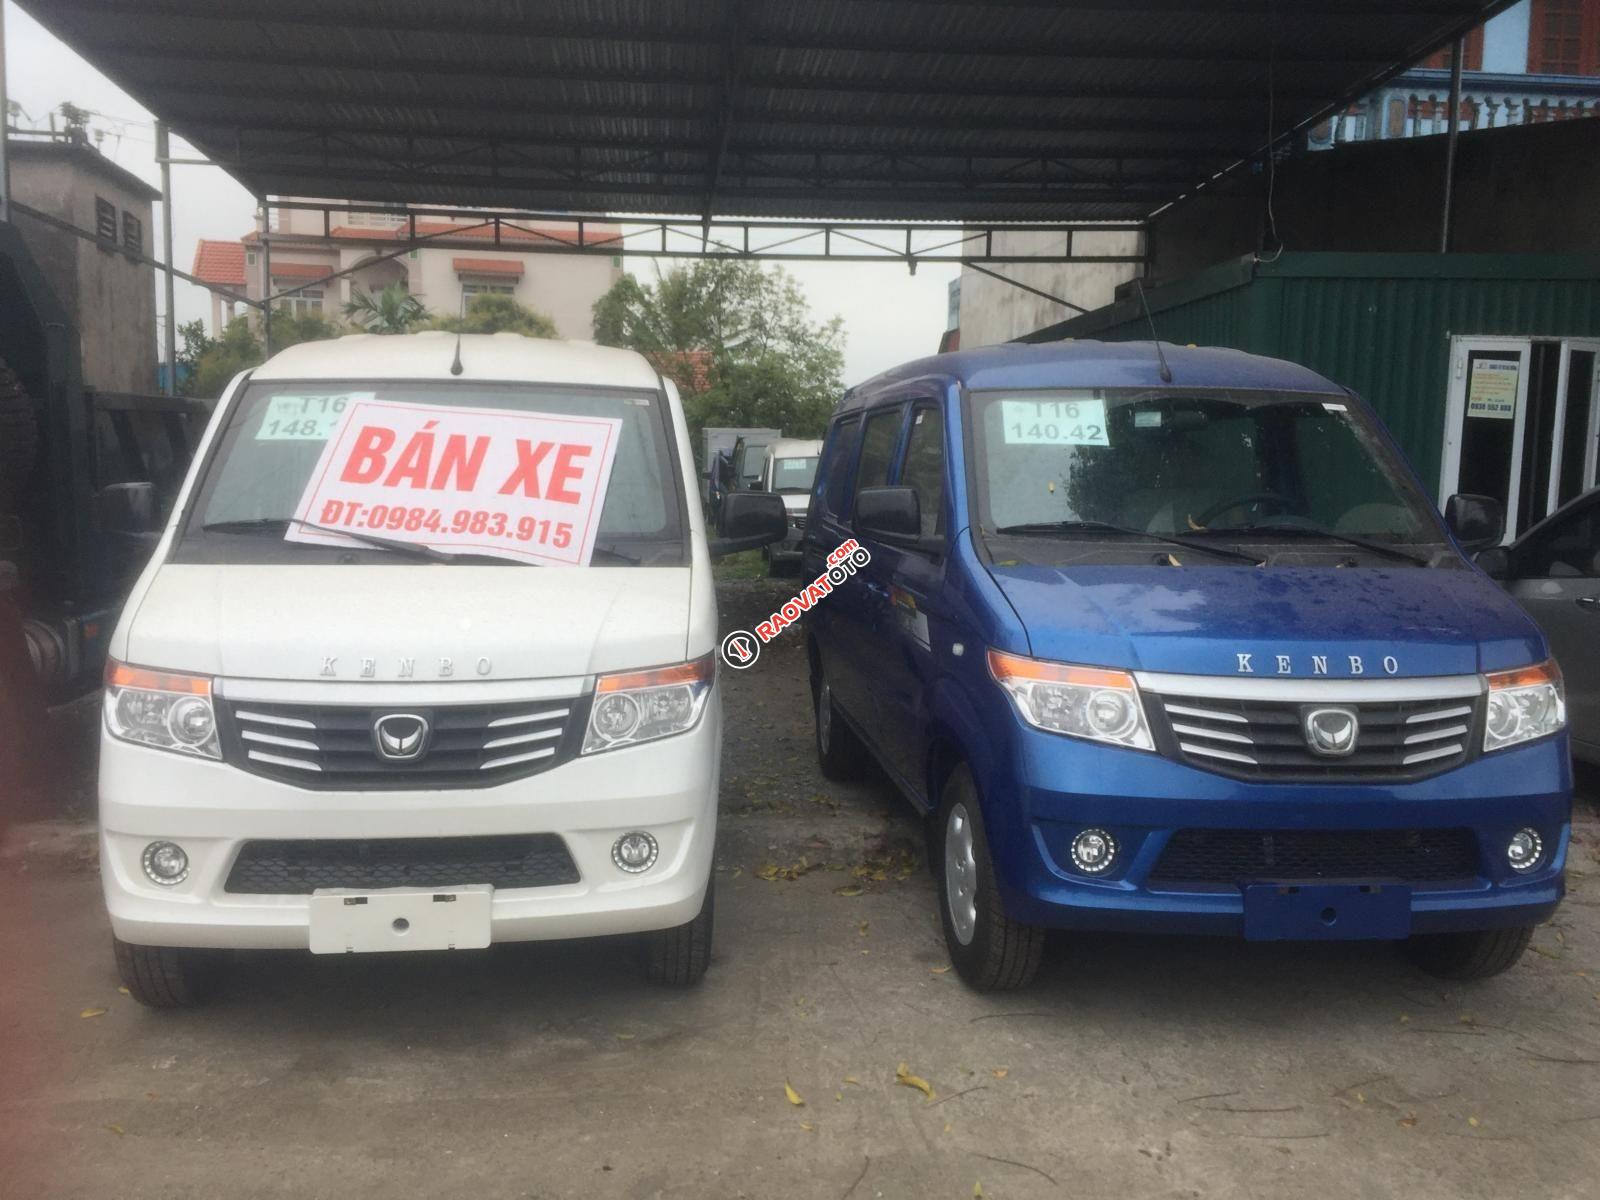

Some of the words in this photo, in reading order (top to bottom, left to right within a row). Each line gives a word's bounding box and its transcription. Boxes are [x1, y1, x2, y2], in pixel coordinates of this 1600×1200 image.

[301, 396, 348, 413] T16
[1011, 423, 1103, 440] 140.42
[339, 420, 491, 492] BÁN
[498, 439, 592, 504] XE
[319, 500, 573, 548] ĐT:0984.983.915
[320, 656, 492, 678] KENBO
[1237, 653, 1398, 674] KENBO
